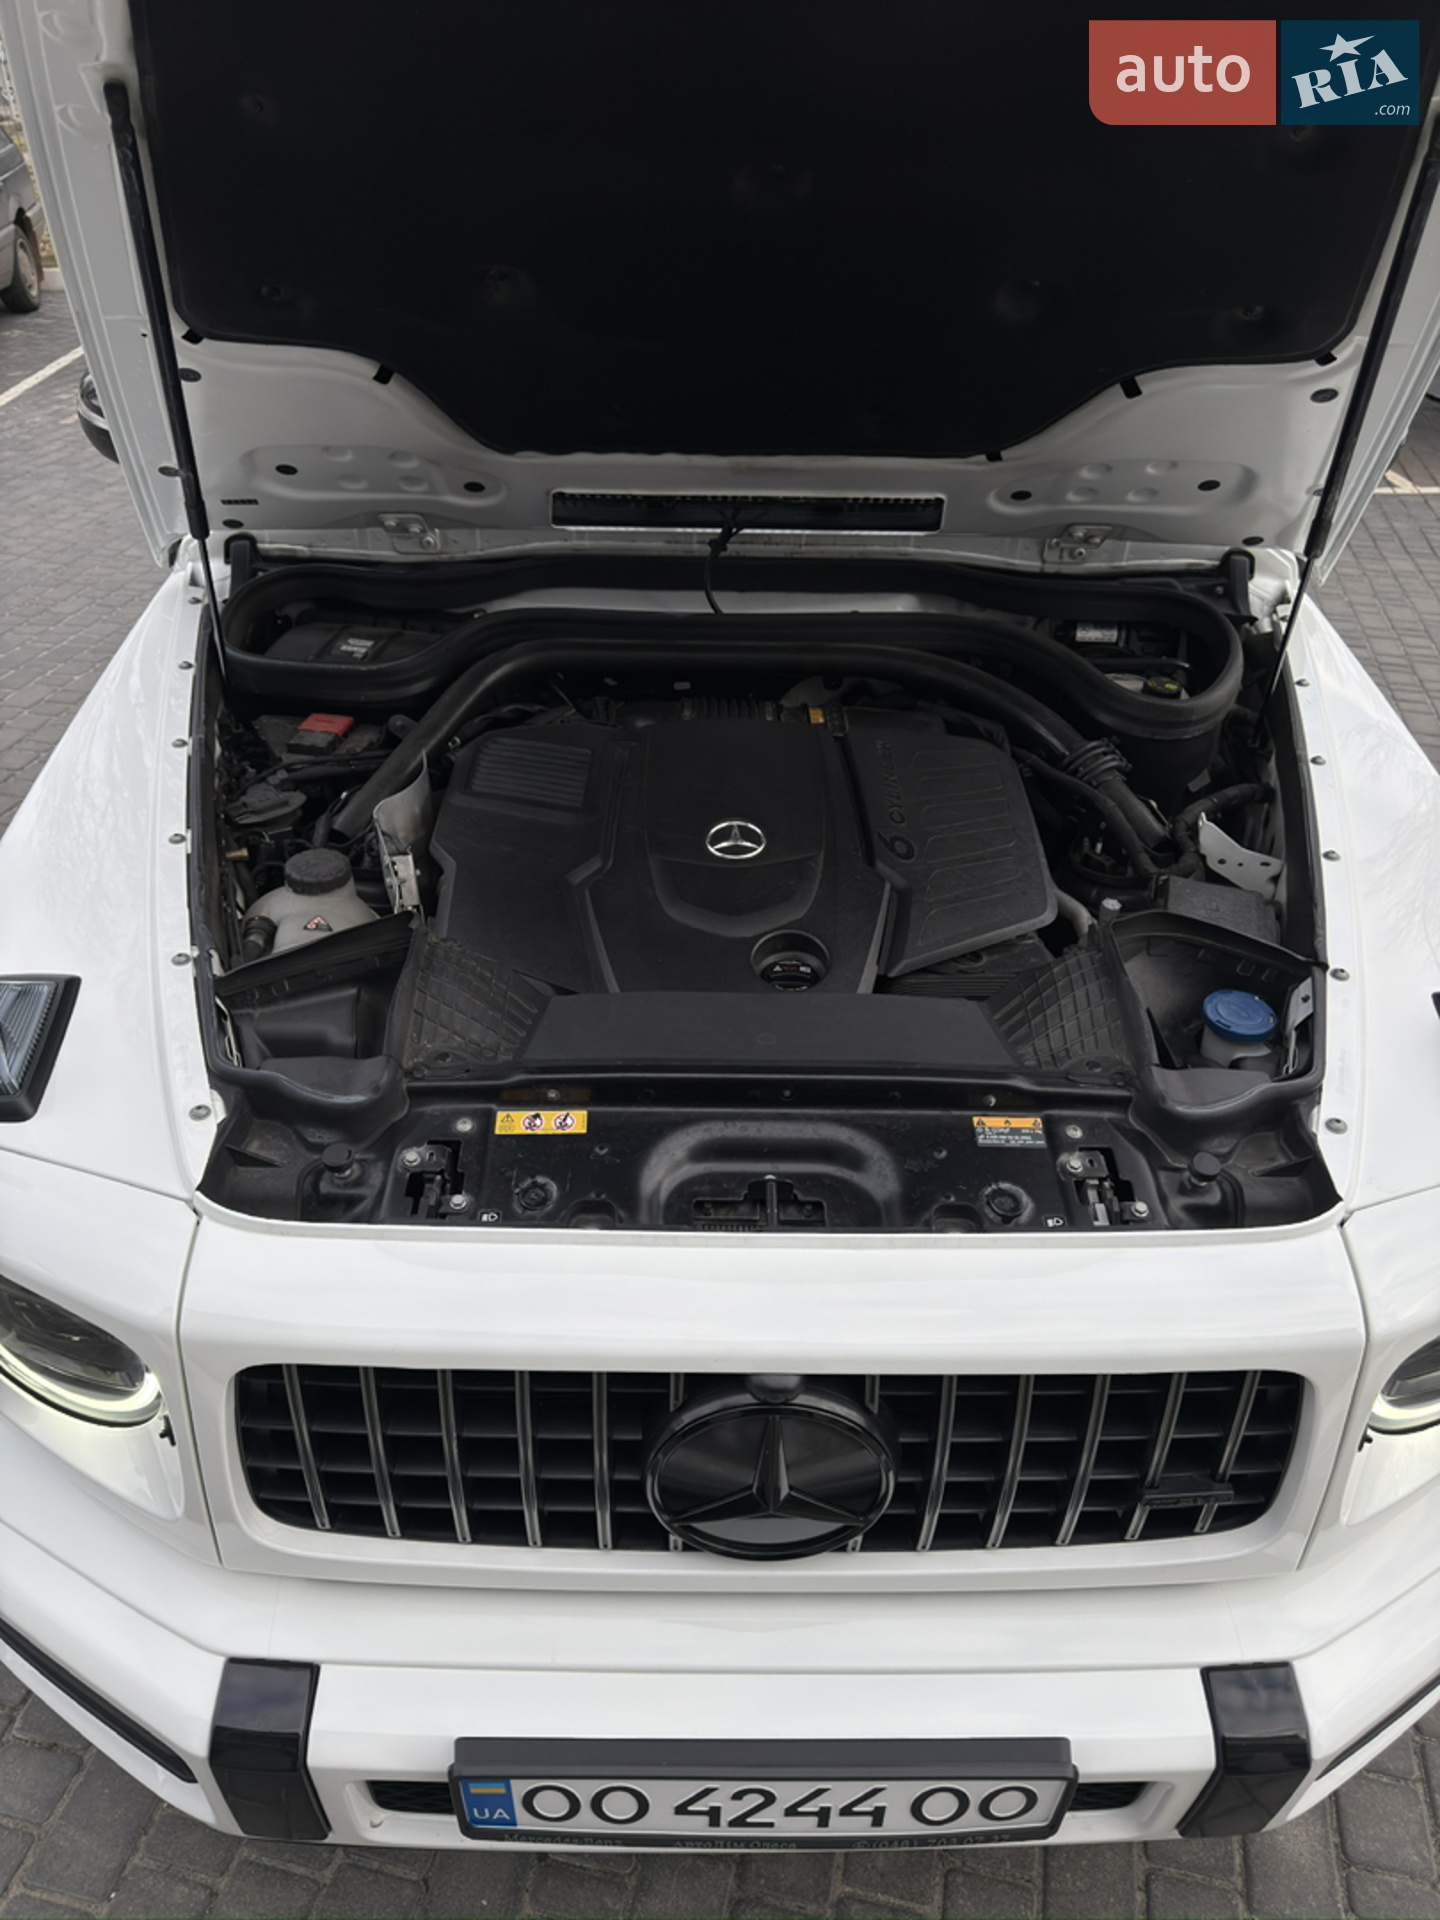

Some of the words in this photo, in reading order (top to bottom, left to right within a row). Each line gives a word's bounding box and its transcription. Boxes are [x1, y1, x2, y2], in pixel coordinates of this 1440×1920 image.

[877, 831, 916, 861] 6
[472, 1807, 511, 1820] UA
[521, 1783, 650, 1825] OO
[673, 1785, 888, 1828] 4244
[910, 1785, 1039, 1827] OO
